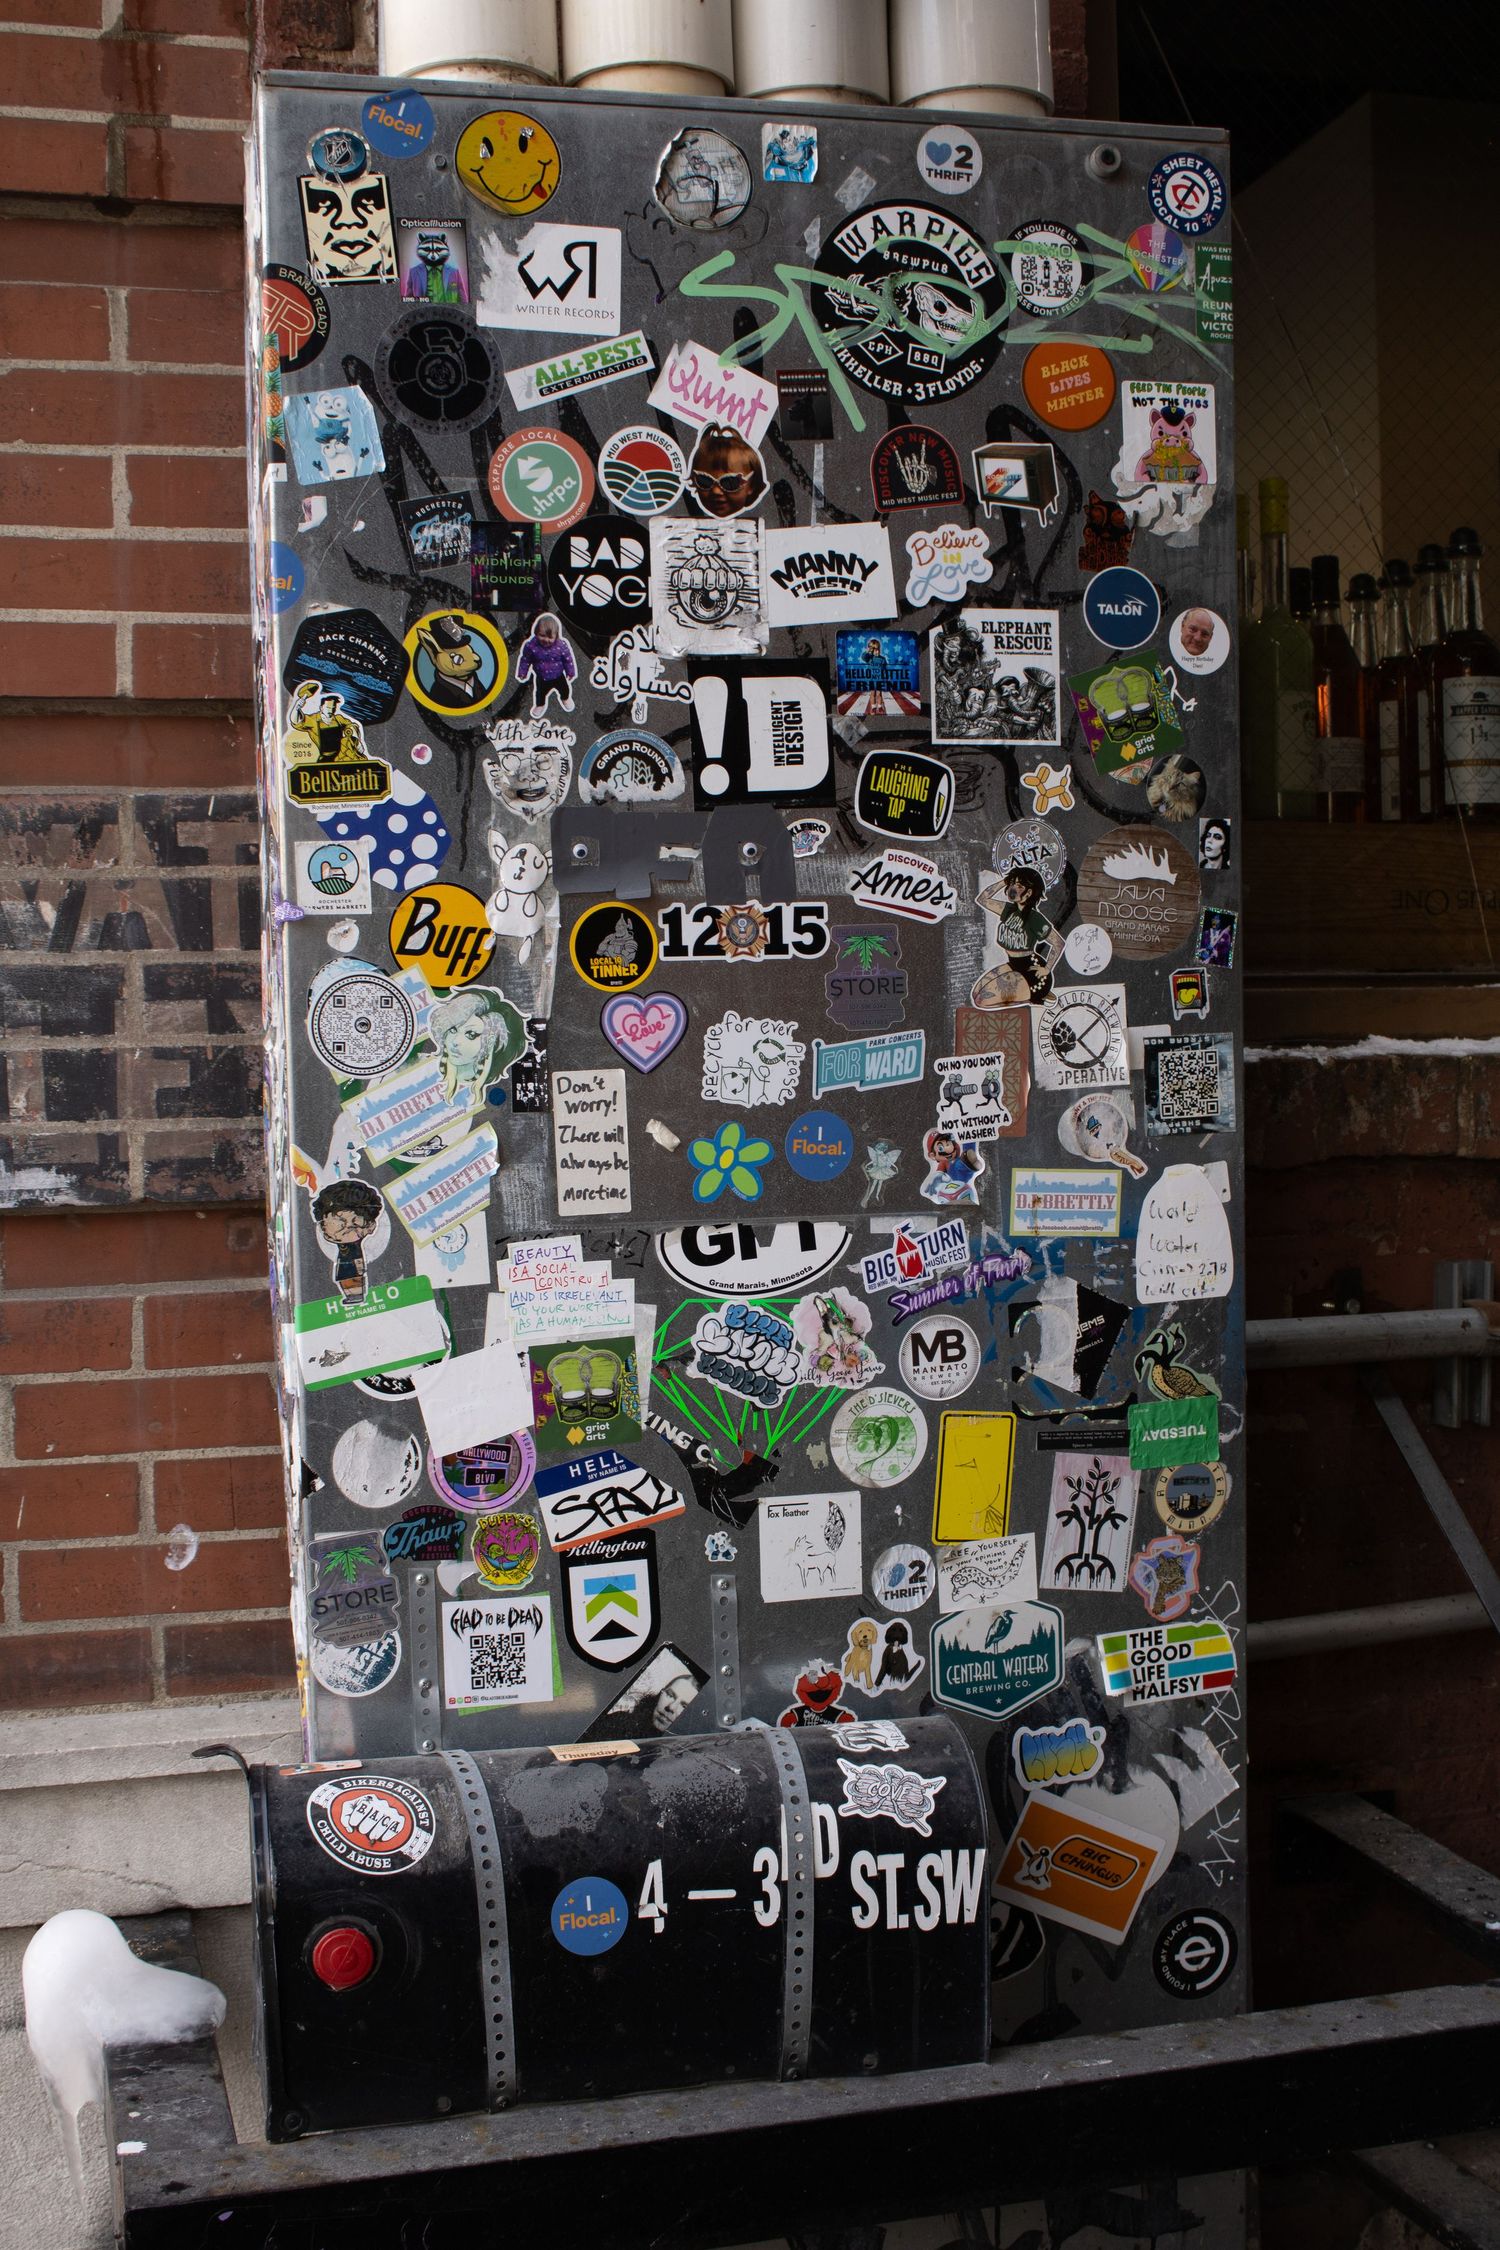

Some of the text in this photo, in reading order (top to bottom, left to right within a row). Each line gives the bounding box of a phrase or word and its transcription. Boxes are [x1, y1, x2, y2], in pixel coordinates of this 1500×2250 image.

[954, 145, 973, 169] 2
[926, 168, 973, 182] THRIFT
[1162, 156, 1224, 211] SHEET METAL
[1152, 188, 1200, 232] LOCAL 10
[1024, 224, 1042, 236] YOU
[1043, 224, 1066, 237] LOVE
[1066, 232, 1078, 246] US
[1148, 239, 1166, 250] THE
[836, 210, 995, 289] WARPIGS
[1127, 248, 1184, 266] ROCHESTER
[883, 250, 949, 274] BREWPUB
[279, 267, 327, 337] BRAND READY
[515, 304, 615, 319] WRITER RECORDS
[535, 336, 642, 387] ALL-PEST
[1041, 355, 1090, 378] BLACK
[542, 358, 645, 396] EXTERMINATING
[1050, 372, 1091, 393] LIVES
[1047, 387, 1104, 412] MATTER
[908, 433, 936, 445] NEW
[492, 431, 559, 491] EXPLORE LOCAL
[620, 431, 682, 475] WEST MUSIC FEST
[532, 475, 577, 516] shrpa
[881, 492, 958, 506] MID WEST MUSIC FEST
[415, 501, 463, 517] ROCHESTER
[556, 501, 586, 528] shrpa.com
[570, 536, 645, 569] BAD
[911, 531, 983, 565] Believe
[474, 556, 538, 568] MIDNIGHT
[770, 551, 879, 590] MANNY
[479, 574, 535, 584] HOUNDS
[790, 578, 862, 598] PHESTO
[1097, 603, 1142, 616] TALON
[981, 621, 1052, 635] ELEPHANT
[318, 633, 389, 666] BACK CHANNEL
[994, 635, 1052, 650] RESCUE
[326, 648, 360, 666] BREWING
[1135, 734, 1156, 747] griot
[1137, 744, 1154, 756] arts
[293, 750, 312, 758] 2016
[631, 741, 668, 775] ROUNDS
[895, 763, 912, 772] THE
[298, 768, 380, 794] BellSmith
[870, 766, 930, 803] LAUGHING
[312, 802, 371, 811] Rochester, Minnesota
[887, 797, 905, 819] TAP
[887, 854, 935, 875] DISCOVER
[1009, 843, 1053, 868] ALTA
[851, 861, 953, 906] Ames
[1109, 883, 1165, 901] JAVA
[1098, 900, 1178, 922] MOOSE
[1105, 920, 1170, 933] GRAND MARAIS
[590, 963, 638, 978] TINNER
[830, 976, 908, 996] STORE
[1040, 998, 1121, 1059] BROKEN BREWING
[868, 1031, 922, 1047] PARK CONCERTS
[821, 1046, 918, 1084] FOR WARD
[937, 1054, 1002, 1072] OH NO YOU DON'T
[556, 1076, 605, 1094] Don't
[564, 1090, 617, 1117] worry!
[941, 1116, 999, 1130] NOT WITHOUT
[558, 1125, 600, 1144] There
[957, 1127, 996, 1141] WASHER!
[792, 1139, 846, 1156] Flocal.
[1043, 1194, 1117, 1209] BRETTLY
[516, 1244, 572, 1262] BEAUTY
[864, 1222, 964, 1284] BIG TURN
[926, 1246, 967, 1268] MUSIC FEST
[709, 1264, 813, 1290] Grand Marais, Minnesota
[892, 1276, 961, 1323] Summer
[359, 1306, 378, 1317] NAME
[911, 1328, 967, 1367] MB
[913, 1372, 969, 1381] BREWERY
[867, 1392, 916, 1413] D'SIEVERS
[586, 1422, 610, 1436] griot
[586, 1431, 606, 1441] arts
[1142, 1424, 1207, 1442] TUESDAY
[475, 1473, 496, 1484] BLVD
[603, 1466, 621, 1478] NAME
[402, 1506, 455, 1520] ROCHESTER
[478, 1513, 534, 1530] DUFFY'S
[768, 1506, 809, 1518] Fox Feather
[386, 1516, 467, 1562] Thaw
[426, 1544, 451, 1552] MUSIC
[422, 1552, 458, 1560] FESTIVAL
[909, 1561, 926, 1584] 2
[315, 1583, 395, 1616] STORE
[884, 1586, 928, 1601] THRIFT
[450, 1604, 543, 1640] GLAD TO BE DEAD
[1130, 1630, 1162, 1648] THE
[1131, 1643, 1191, 1666] GOOD
[947, 1654, 1049, 1685] CENTRAL WATERS
[1132, 1664, 1165, 1684] LIFE
[966, 1680, 1031, 1694] BREWING CO.
[1132, 1676, 1201, 1701] HALFSY
[560, 1749, 618, 1760] Thursday
[867, 1781, 910, 1801] COVE
[342, 1779, 430, 1827] BIKERS AGAINST
[317, 1819, 392, 1869] CHILD ABUSE
[1060, 1852, 1122, 1884] CHUNGUS
[560, 1906, 620, 1931] Flocal.
[1161, 1920, 1188, 1991] FOUND PLACE
